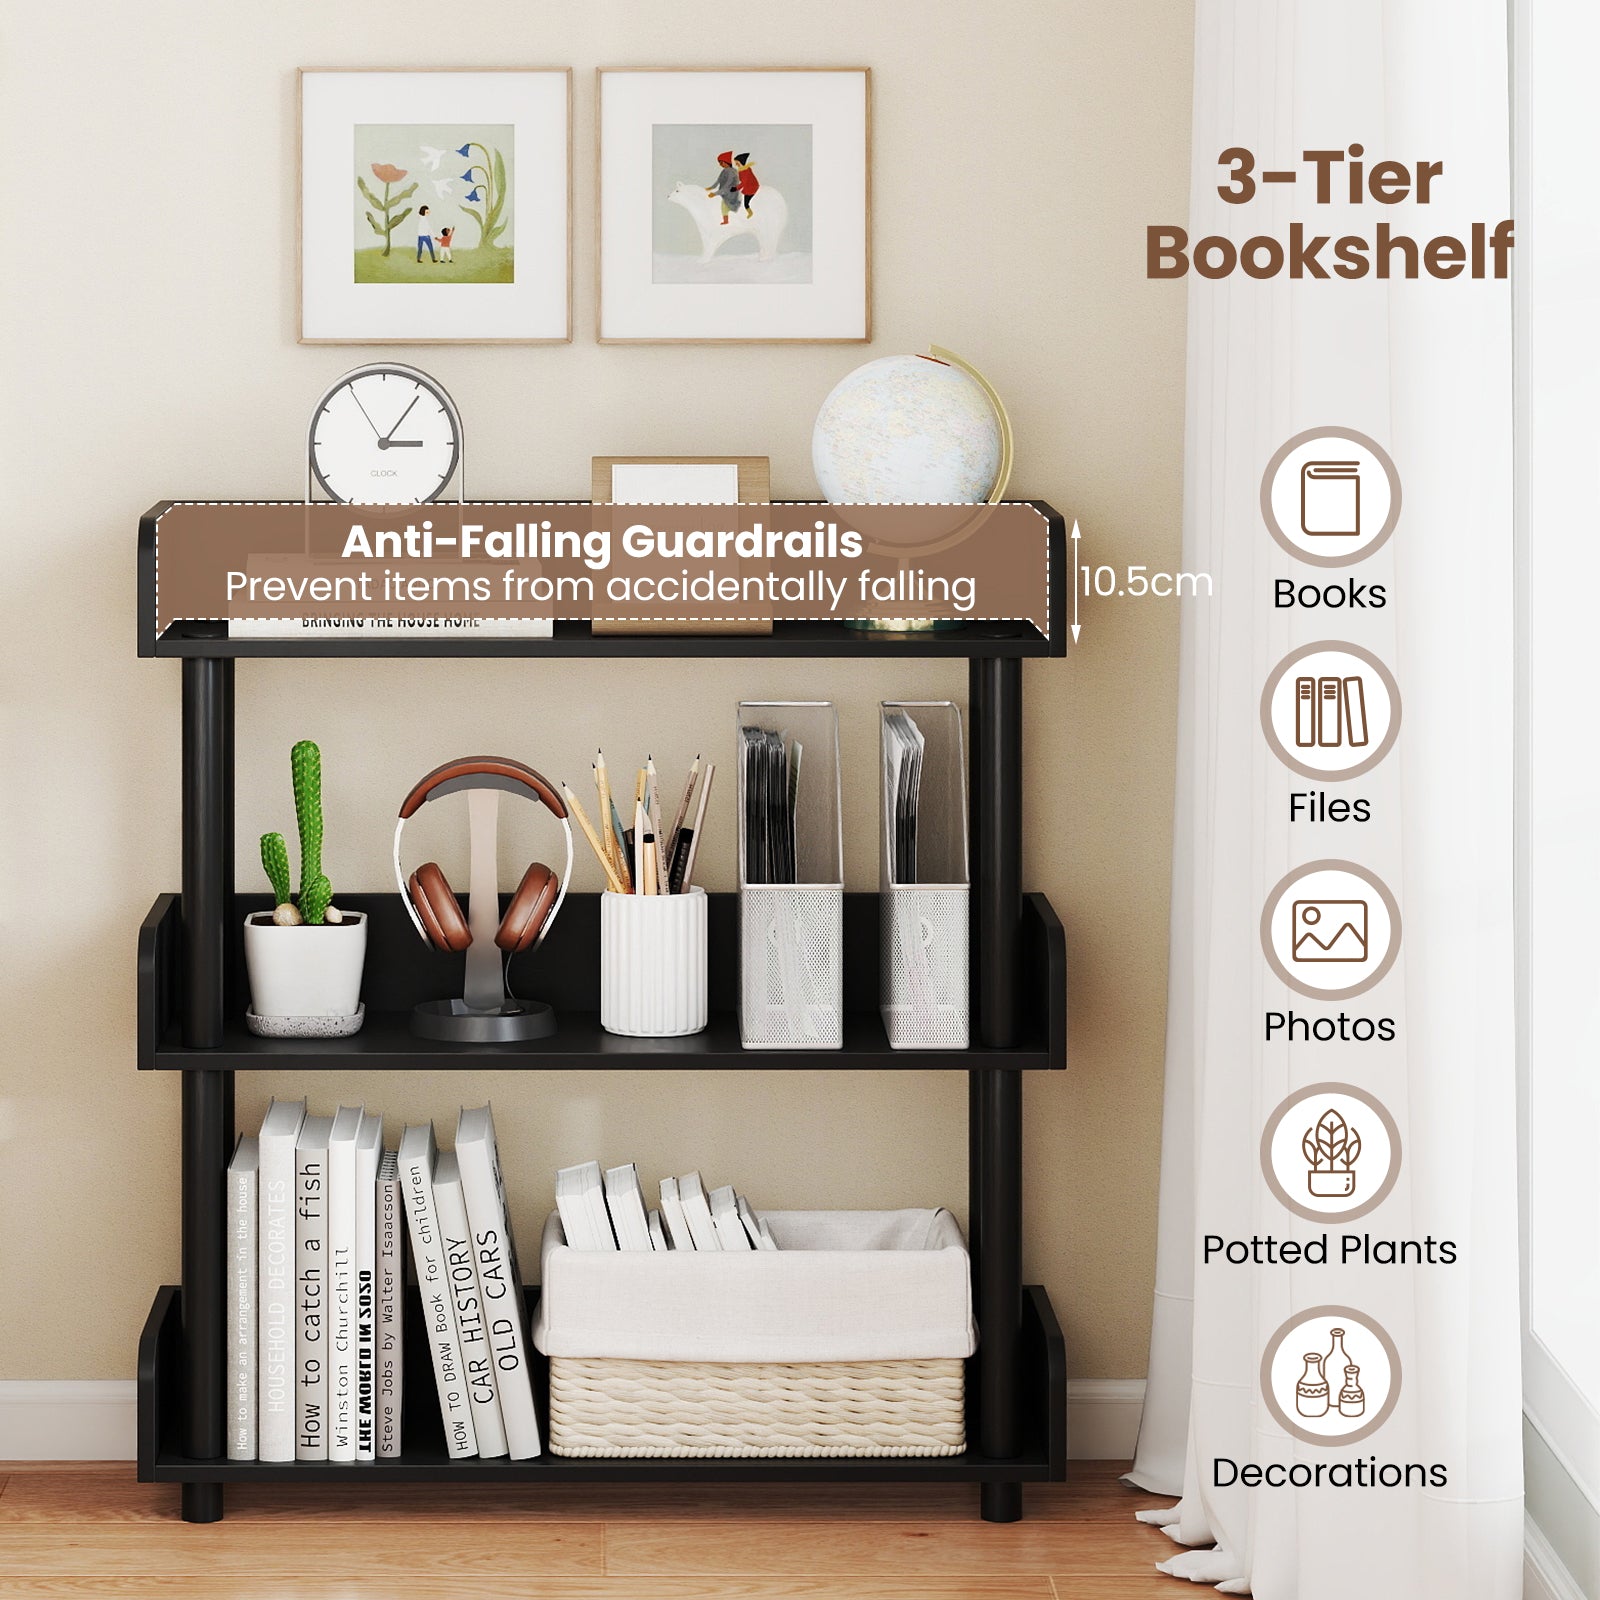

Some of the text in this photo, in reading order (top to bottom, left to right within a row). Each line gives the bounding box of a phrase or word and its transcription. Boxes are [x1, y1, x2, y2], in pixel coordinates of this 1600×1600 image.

[370, 469, 398, 478] CLOCK
[370, 612, 393, 628] THE
[398, 612, 440, 628] HOUSE
[236, 1177, 250, 1450] How to make an arrangement in the house
[267, 1180, 285, 1412] HOUSEHOLD DECORATES
[299, 1163, 321, 1448] How to catch a fish
[334, 1248, 349, 1448] Winston Churchill
[380, 1184, 396, 1452] Steve Jobs by Walter Isaacson
[409, 1165, 468, 1451] HOW TO DRAW Book for children
[446, 1237, 494, 1404] CAR HISTORY
[476, 1230, 519, 1371] OLD CARS
